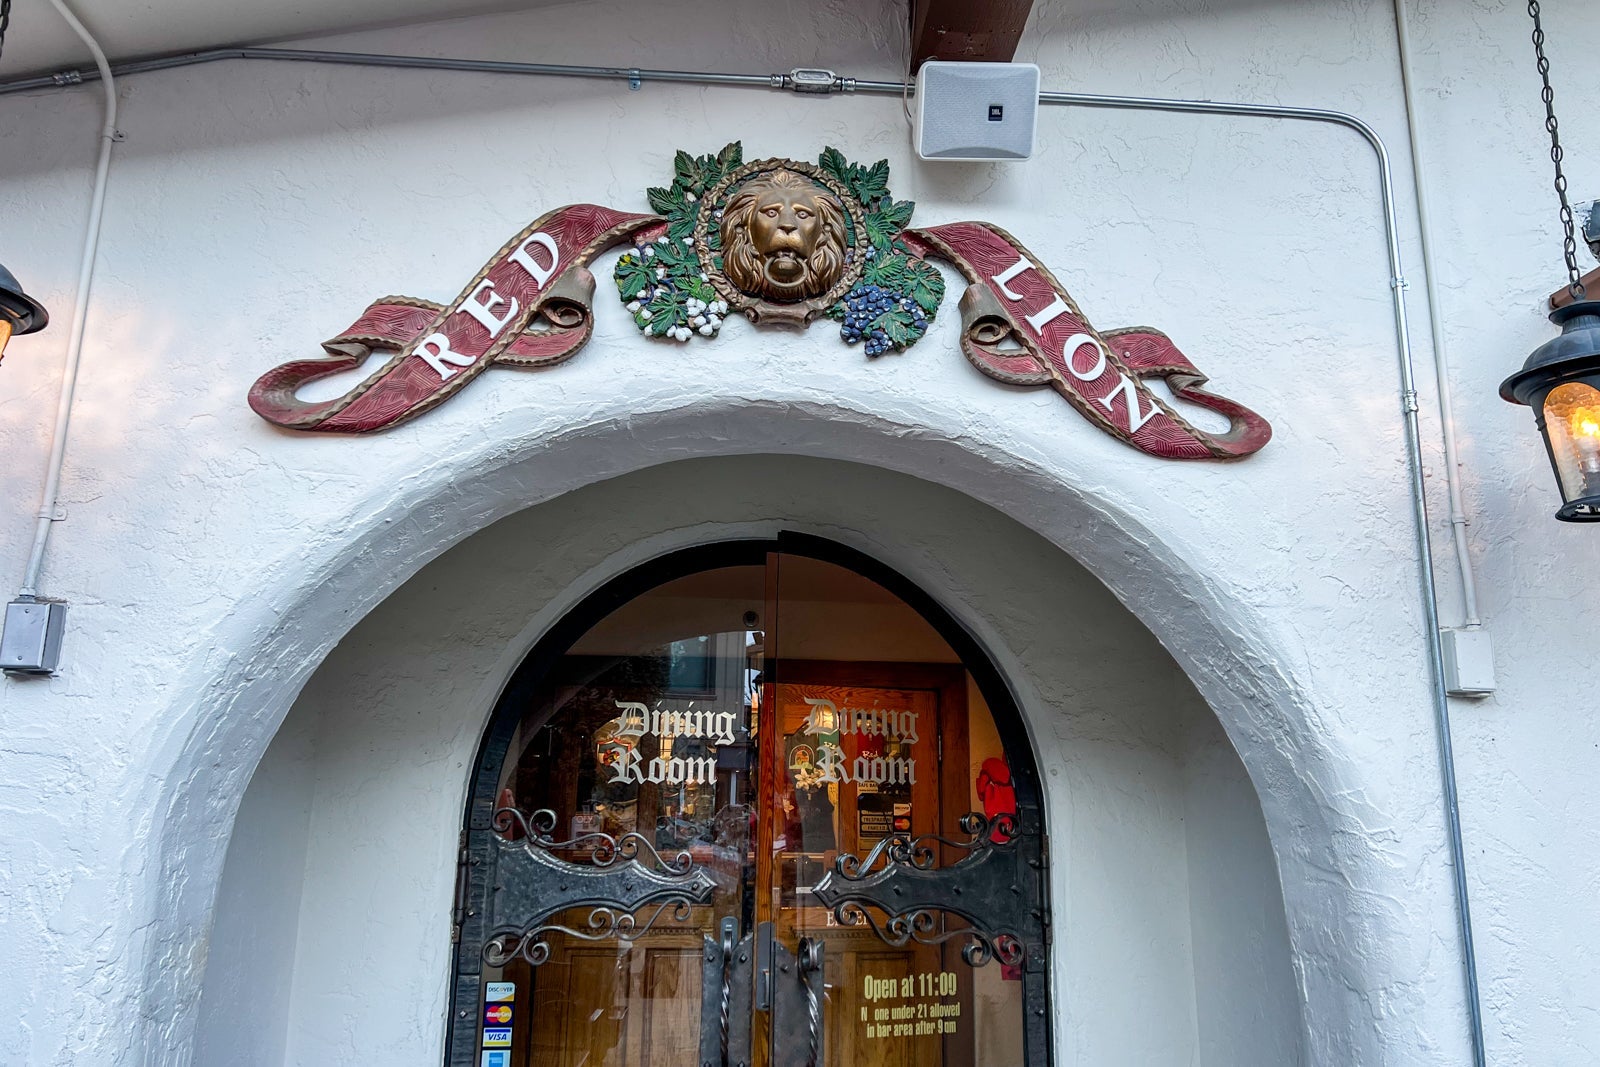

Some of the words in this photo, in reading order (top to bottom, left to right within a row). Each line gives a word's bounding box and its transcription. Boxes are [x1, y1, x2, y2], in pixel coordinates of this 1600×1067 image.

[412, 231, 560, 381] RED
[991, 254, 1165, 434] LION
[613, 699, 737, 746] Dining
[803, 696, 919, 744] Dining
[608, 747, 718, 784] Room
[815, 745, 917, 785] Room
[864, 975, 898, 1002] Open
[901, 974, 914, 998] at
[918, 971, 957, 996] 11:00
[866, 1023, 875, 1038] in
[876, 1023, 892, 1038] bar
[893, 1023, 913, 1037] area
[915, 1020, 936, 1036] after
[874, 1008, 890, 1020] one
[891, 1004, 915, 1020] under
[917, 1003, 927, 1018] 21
[930, 1002, 960, 1018] allowed
[488, 1033, 507, 1041] VISA
